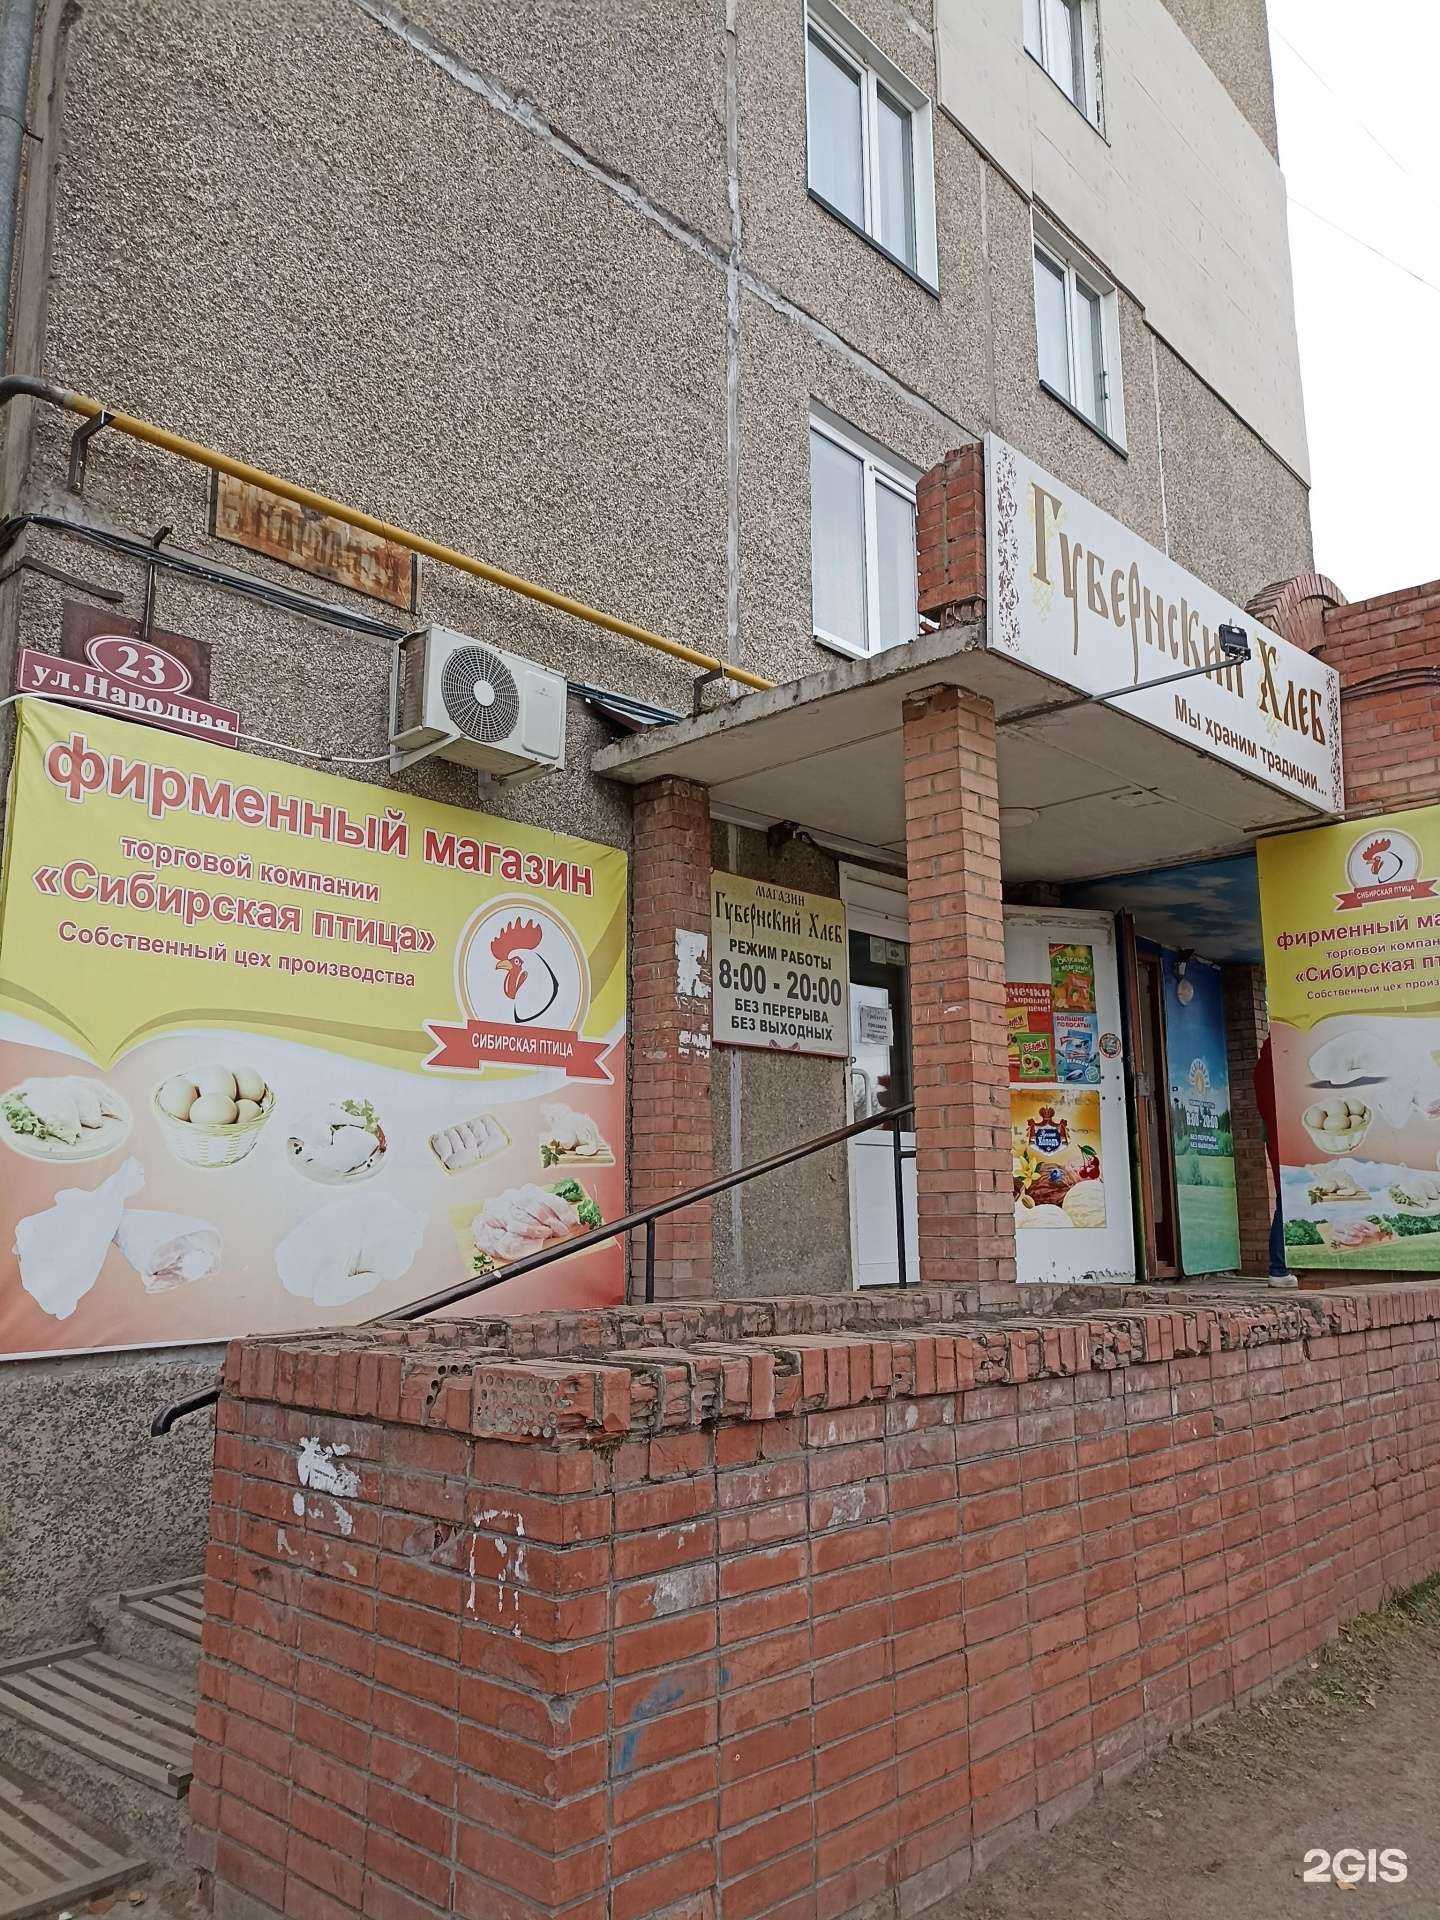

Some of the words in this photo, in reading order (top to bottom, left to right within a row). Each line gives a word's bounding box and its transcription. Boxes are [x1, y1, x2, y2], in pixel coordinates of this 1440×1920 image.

[115, 645, 167, 686] 23
[1174, 694, 1201, 729] Мы
[1205, 717, 1258, 759] храним
[1259, 745, 1327, 796] традиции...
[46, 734, 409, 857] фирменный
[424, 829, 594, 896] магазин
[121, 838, 252, 879] торговой
[260, 864, 380, 902] компании
[33, 861, 302, 934] «Сибирская
[313, 910, 437, 953] птица»
[1356, 886, 1394, 899] СИБИРСКАЯ
[1394, 884, 1416, 894] ПТИЦА
[1276, 914, 1409, 950] фирменный
[58, 921, 228, 962] Собственный
[234, 949, 272, 968] цех
[278, 956, 416, 987] производства
[729, 938, 778, 961] РЕЖИМ
[781, 948, 832, 971] РАБОТЫ
[1327, 945, 1386, 960] торговой
[719, 958, 767, 995] 8:00
[786, 971, 842, 1007] 20:00
[1295, 958, 1415, 983] «Сибирская
[1006, 987, 1050, 998] мечки
[1306, 986, 1380, 1000] Собственный
[1383, 983, 1402, 992] цех
[734, 998, 760, 1014] БЕЗ
[762, 1002, 829, 1024] ПЕРЕРЫВА
[471, 1031, 537, 1054] СИБИРСКАЯ
[539, 1039, 574, 1058] ПТИЦА
[731, 1015, 756, 1031] БЕЗ
[760, 1019, 833, 1042] ВЫХОДНЫХ
